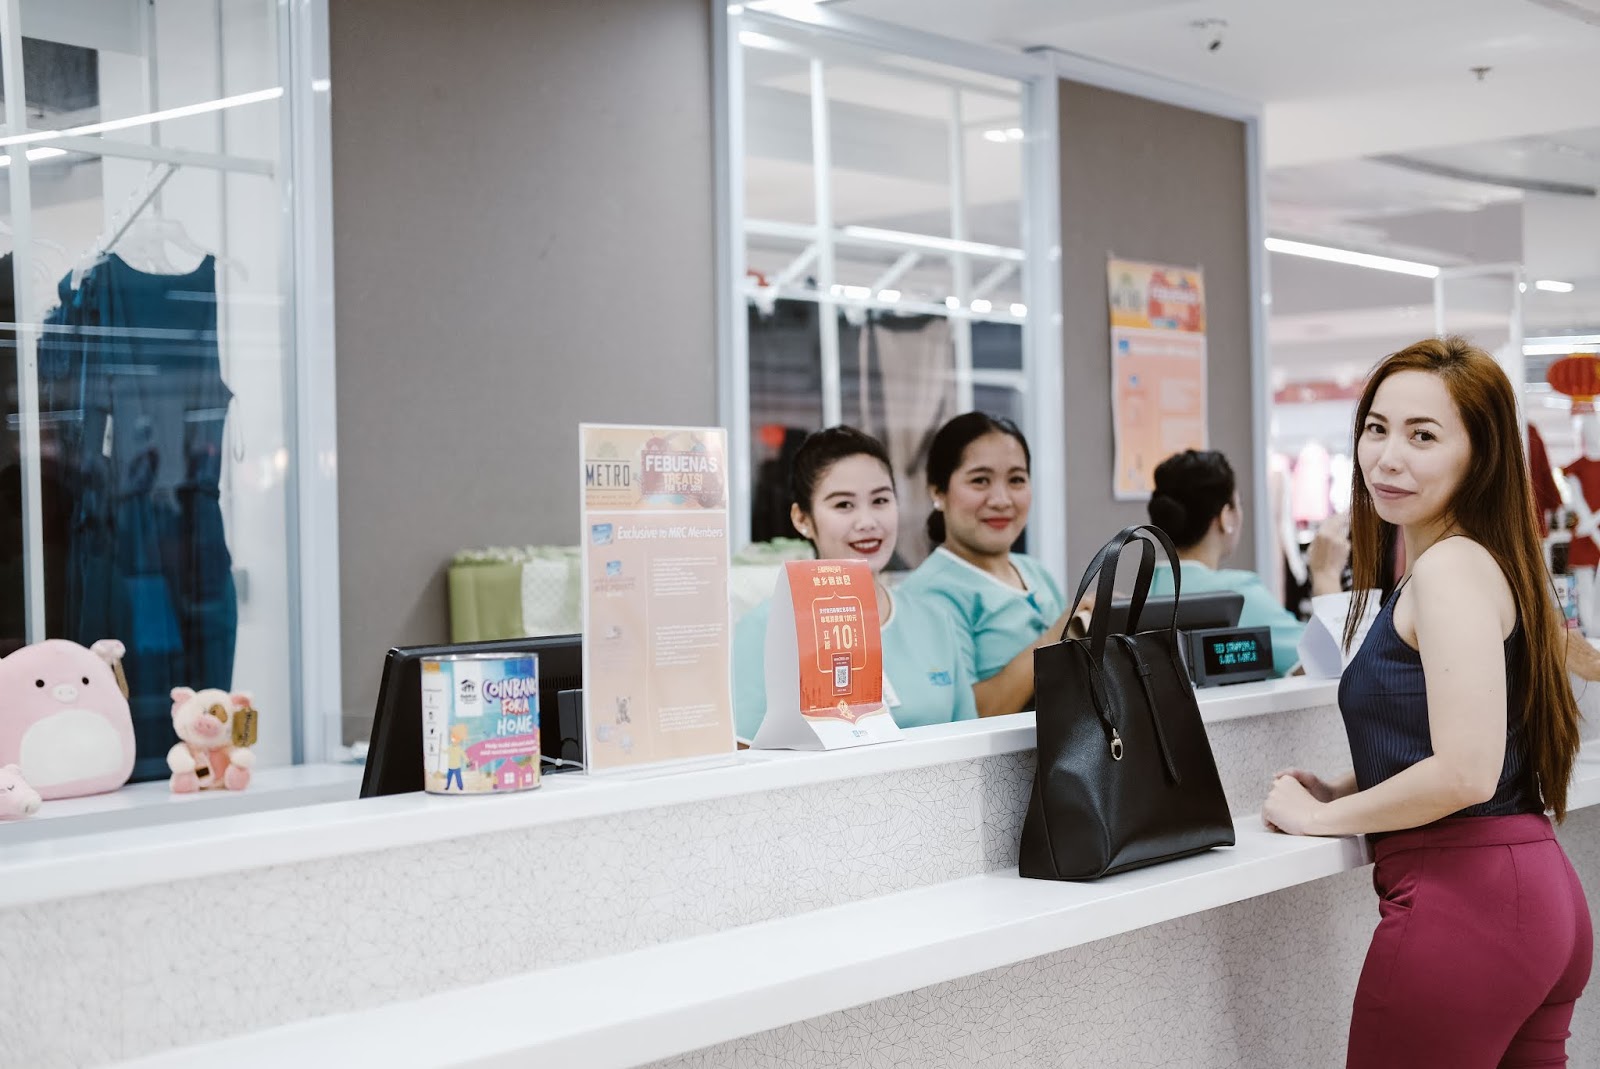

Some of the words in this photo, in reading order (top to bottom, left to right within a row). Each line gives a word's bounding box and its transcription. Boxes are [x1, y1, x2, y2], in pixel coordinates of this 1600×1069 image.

[645, 454, 718, 473] FEBUENAS
[586, 464, 630, 487] METRO
[617, 526, 658, 540] Exclusive
[659, 527, 668, 539] to
[668, 526, 687, 539] MRC
[687, 525, 724, 538] Members
[832, 624, 853, 650] 10
[496, 715, 534, 737] HOME
